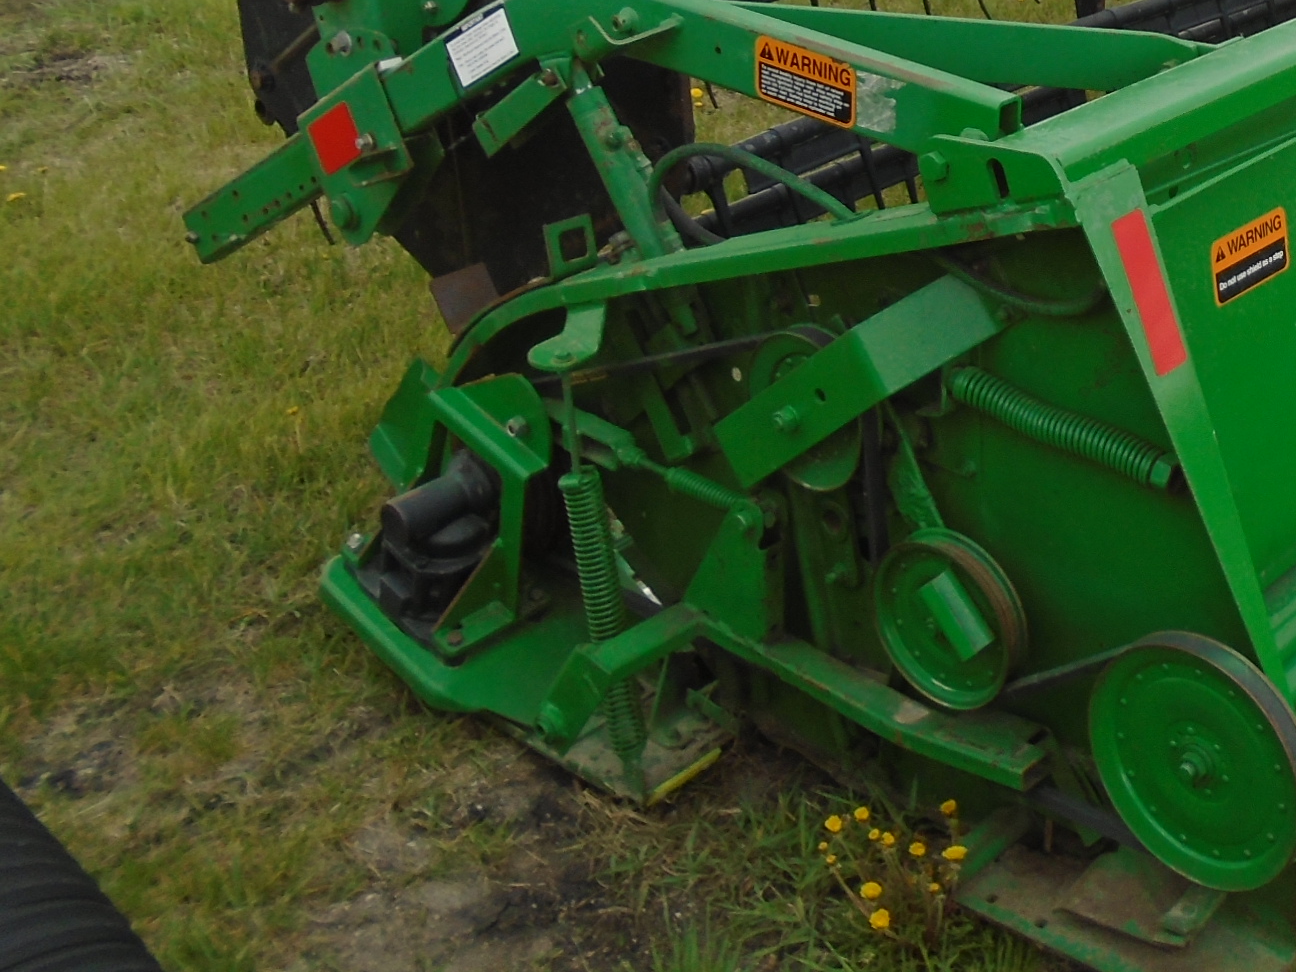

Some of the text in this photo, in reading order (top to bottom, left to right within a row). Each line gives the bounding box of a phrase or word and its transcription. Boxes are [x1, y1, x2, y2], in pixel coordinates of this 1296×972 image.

[775, 46, 851, 87] WARNING
[1226, 215, 1282, 255] WARNING
[1219, 282, 1228, 291] Do
[1227, 275, 1237, 287] not
[1236, 271, 1247, 281] use
[1246, 261, 1262, 276] shield
[1262, 259, 1269, 267] as
[1273, 250, 1284, 260] step
